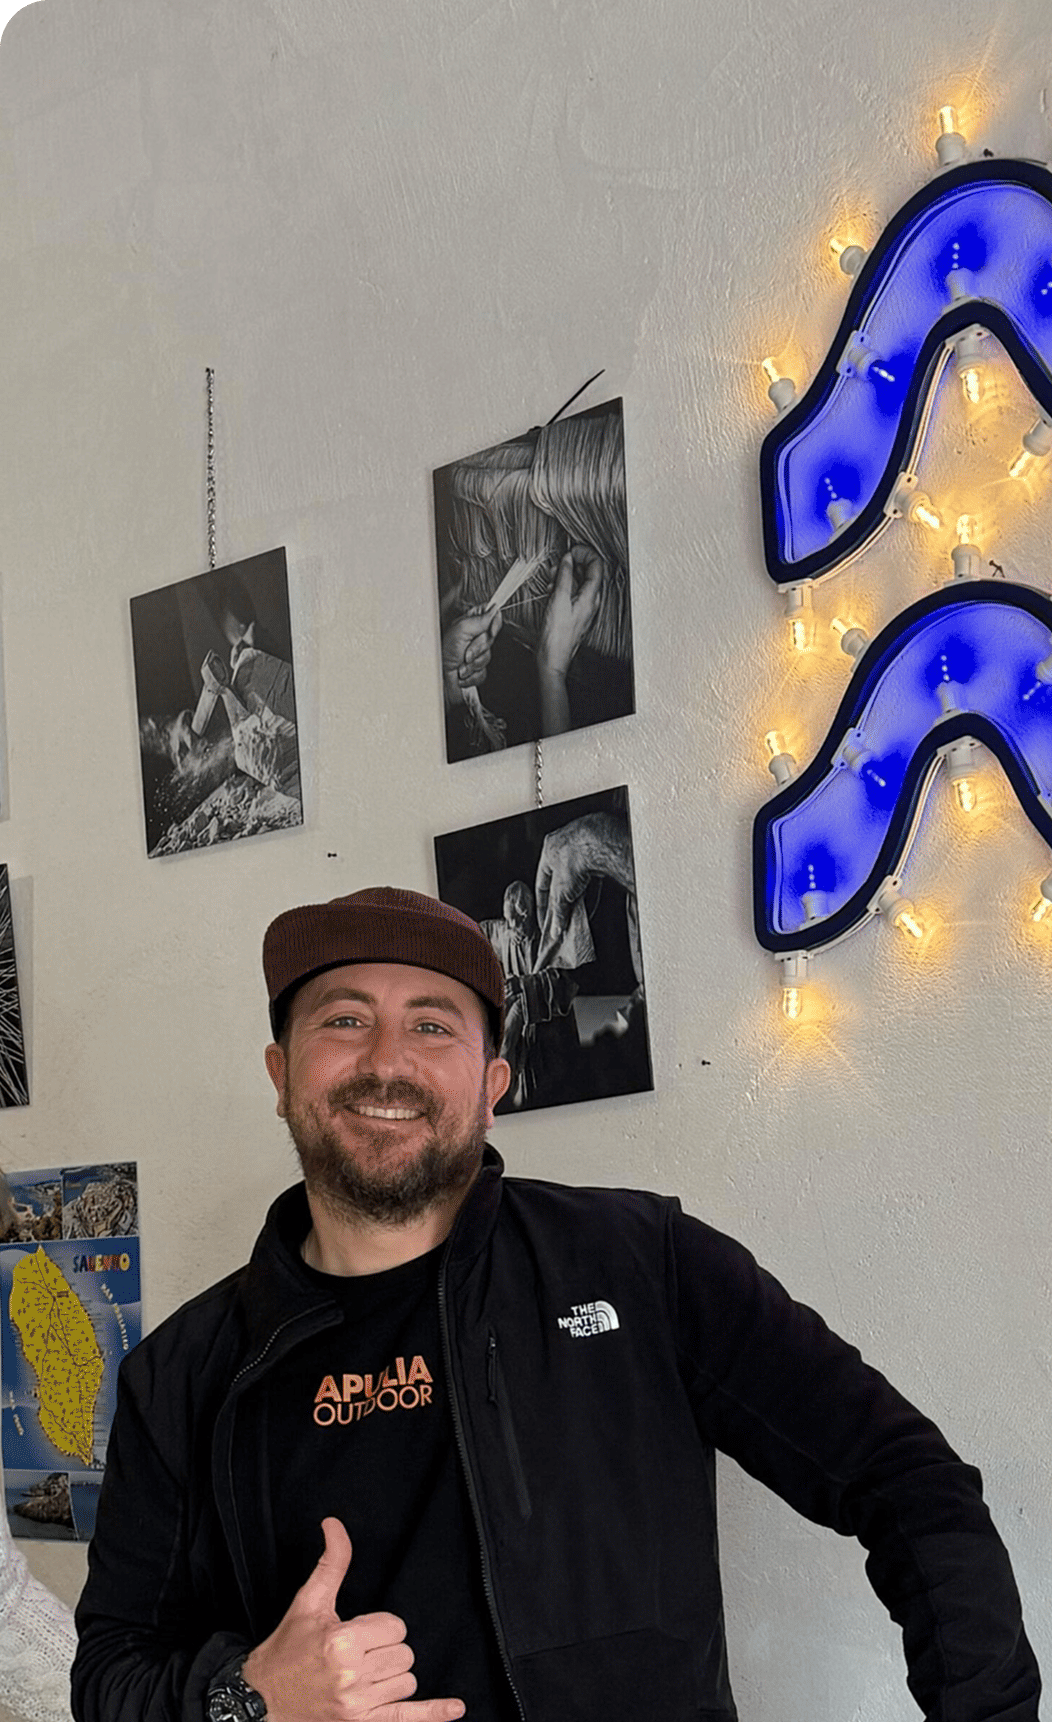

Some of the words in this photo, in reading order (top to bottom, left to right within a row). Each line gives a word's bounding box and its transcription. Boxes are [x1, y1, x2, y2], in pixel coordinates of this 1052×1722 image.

[570, 1302, 595, 1316] THE
[557, 1312, 597, 1330] NORTH
[570, 1323, 599, 1338] FACE
[314, 1355, 433, 1403] APULIA
[313, 1384, 433, 1426] OUTDOOR
